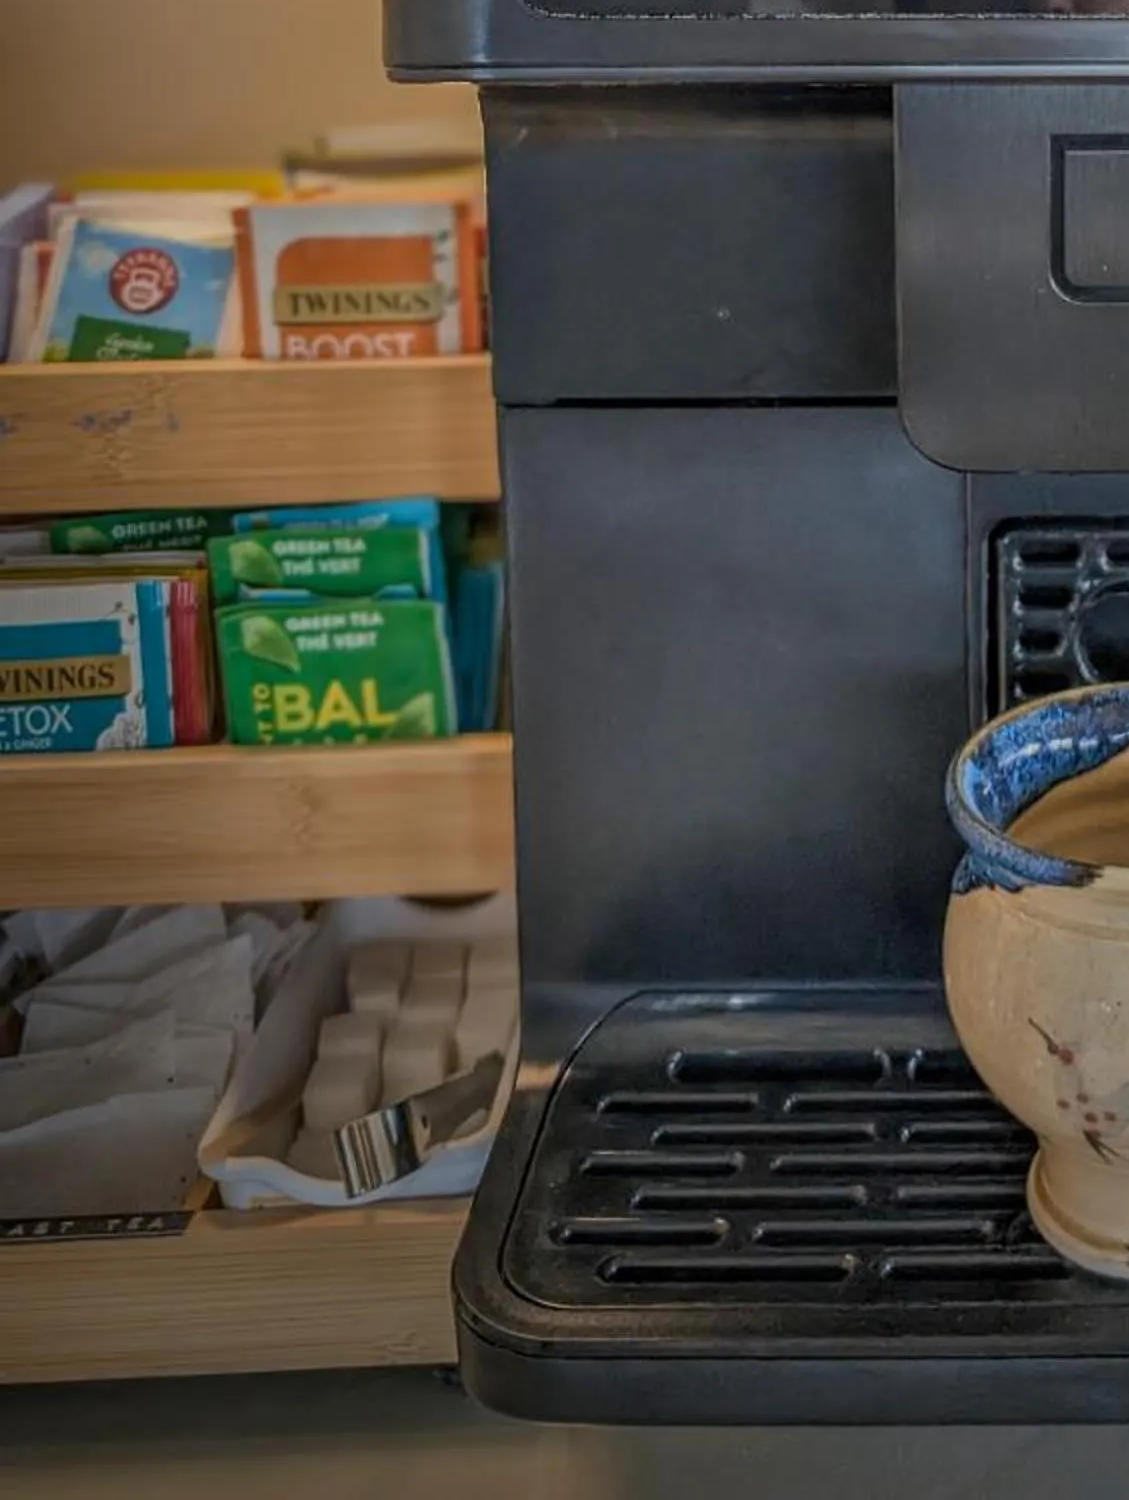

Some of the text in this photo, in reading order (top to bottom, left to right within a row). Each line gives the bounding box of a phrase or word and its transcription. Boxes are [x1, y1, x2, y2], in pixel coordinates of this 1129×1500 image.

[288, 291, 432, 317] TWININGS
[286, 331, 416, 358] BOOST
[111, 515, 208, 539] GREEN TEA
[272, 536, 366, 556] GREEN TEA
[320, 557, 362, 574] VERT
[284, 611, 383, 632] GREEN TEA
[334, 631, 377, 648] VERT
[274, 678, 396, 732] BAL
[107, 1217, 163, 1230] TEA
